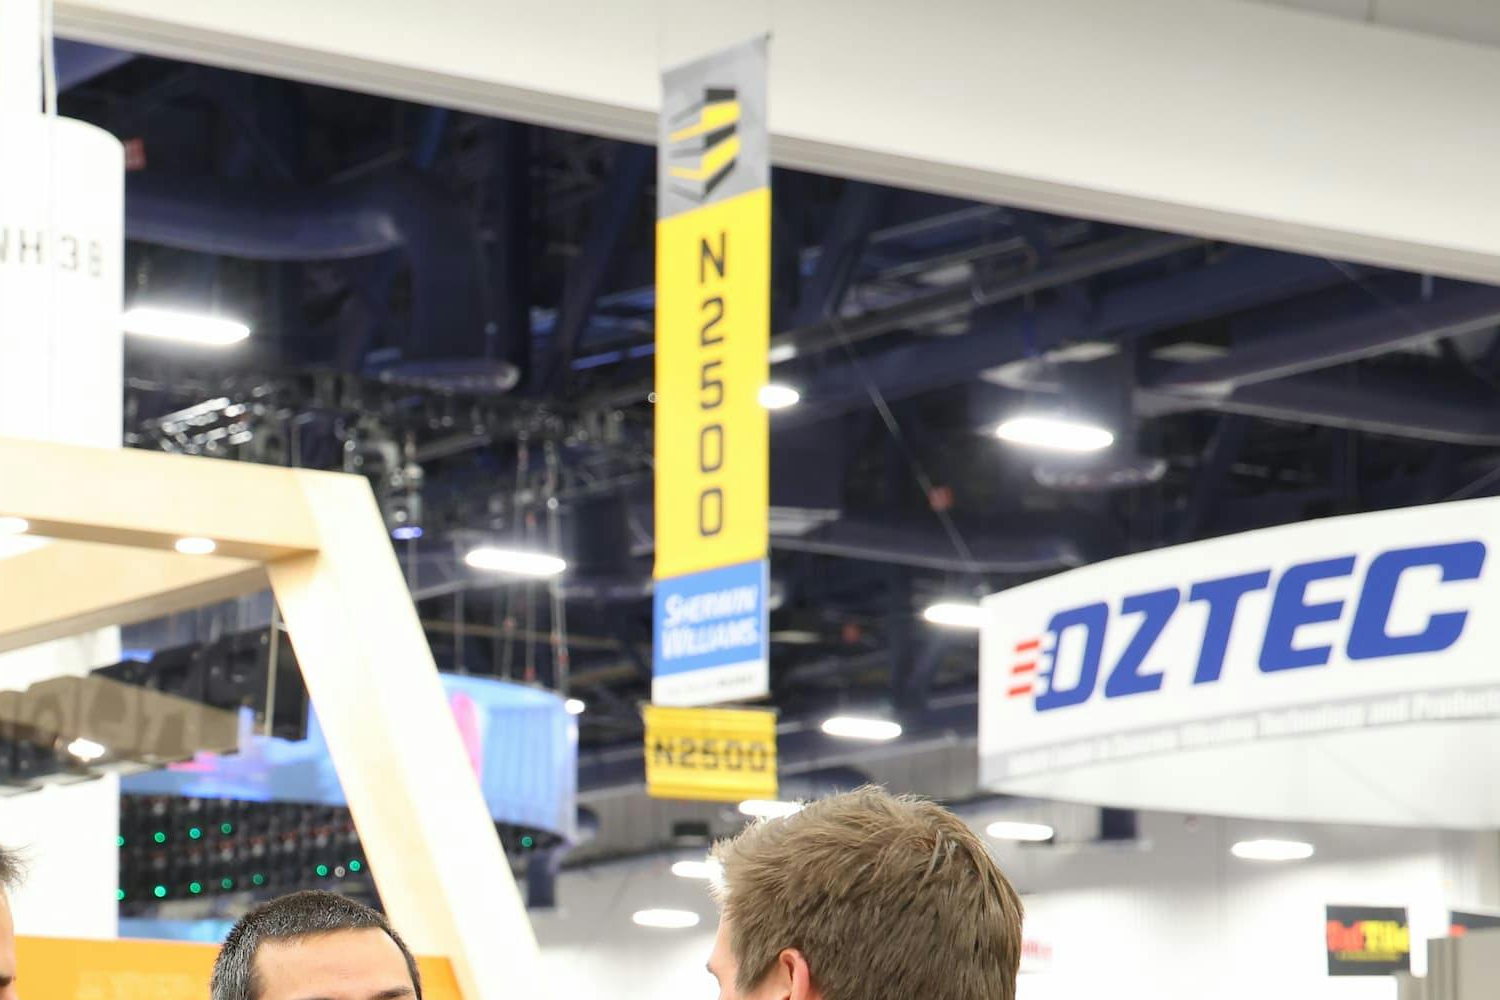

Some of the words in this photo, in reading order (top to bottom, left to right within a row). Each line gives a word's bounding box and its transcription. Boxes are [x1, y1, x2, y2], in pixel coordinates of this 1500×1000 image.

[699, 231, 727, 537] N2500
[1034, 540, 1487, 712] OZTEC
[652, 737, 768, 773] N2500
